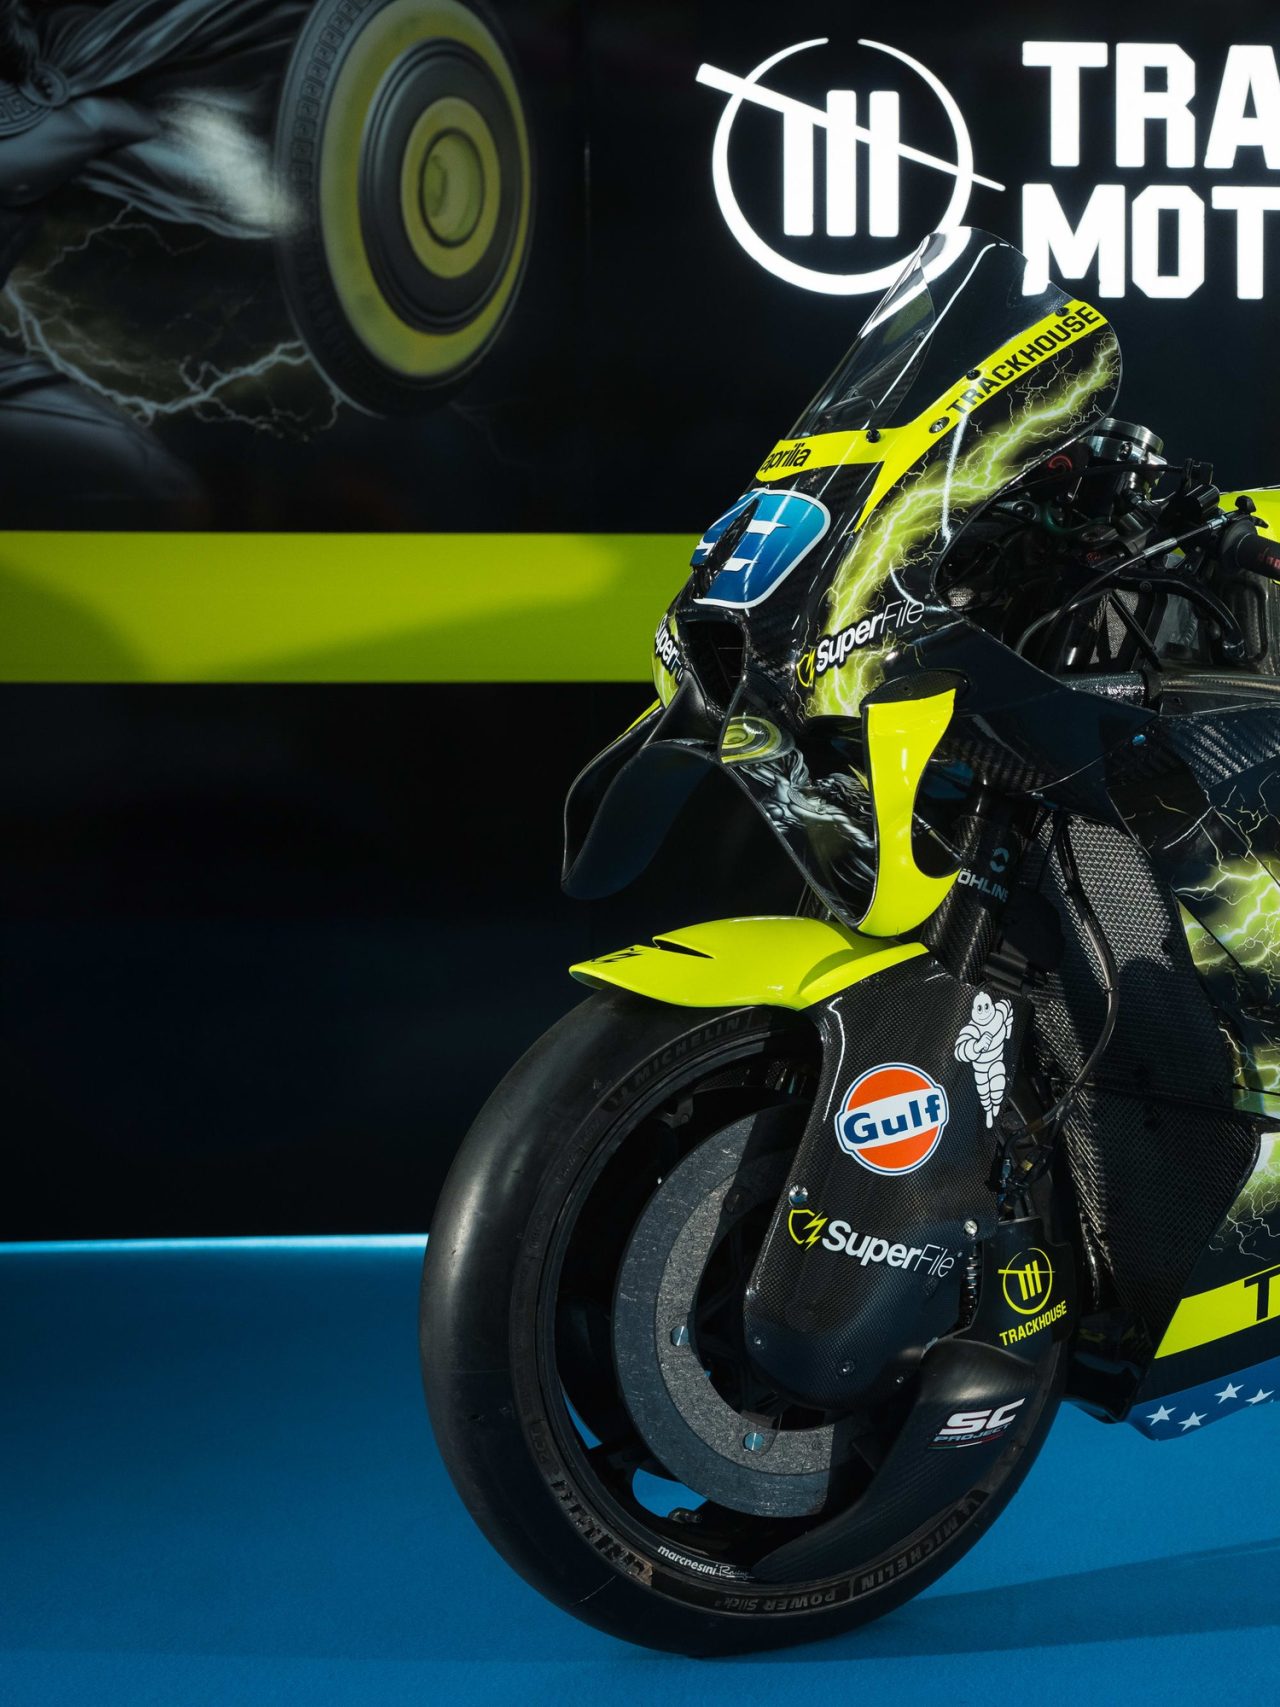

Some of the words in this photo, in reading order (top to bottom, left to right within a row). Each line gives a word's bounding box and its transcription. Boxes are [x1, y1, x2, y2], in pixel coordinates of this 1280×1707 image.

[945, 305, 1101, 415] TRACKHOUSE
[816, 600, 925, 672] SuperFile
[633, 1016, 741, 1087] MICHELIN
[844, 1094, 940, 1144] Gulf
[822, 1220, 955, 1278] SuperFile
[999, 1299, 1068, 1346] TRACKHOUSE
[934, 1422, 1012, 1443] PROJECT
[936, 1398, 1026, 1435] SC
[859, 1511, 960, 1592] MICHELIN
[764, 1586, 836, 1612] POWER
